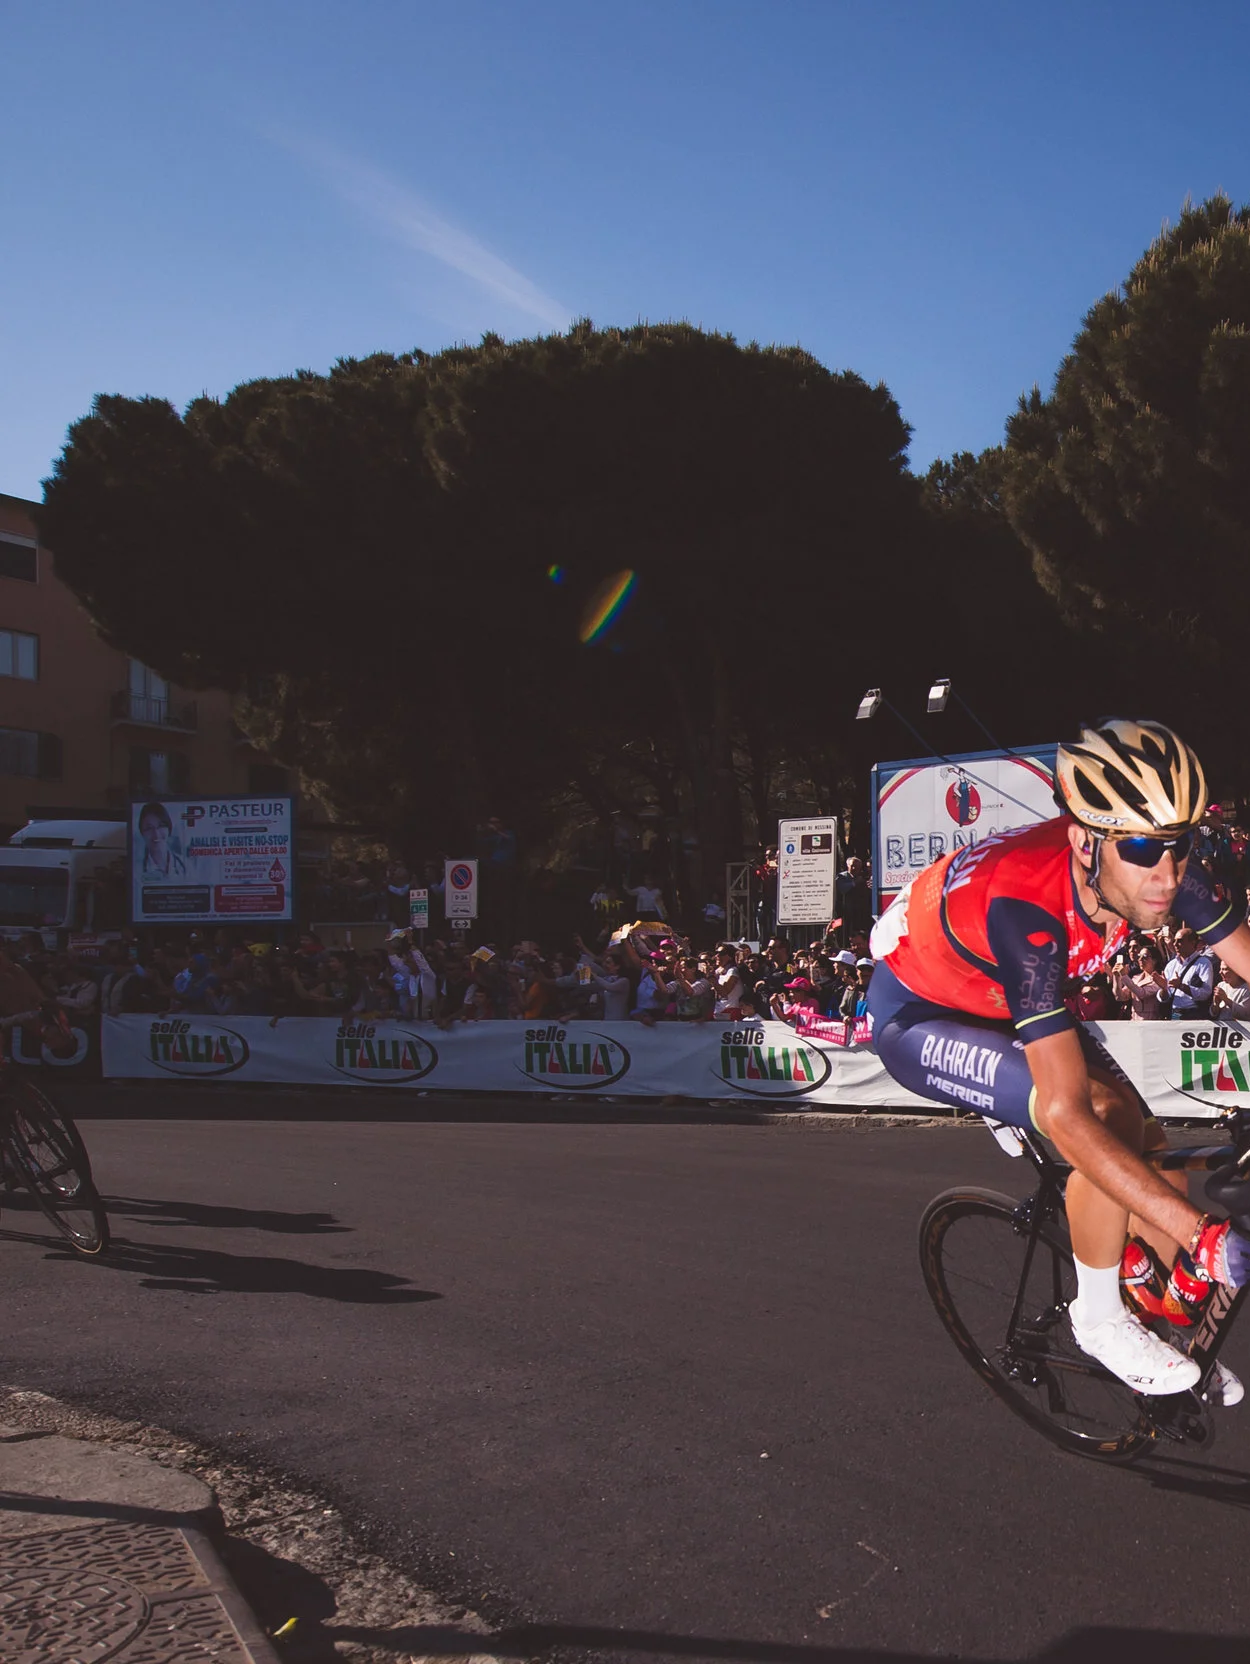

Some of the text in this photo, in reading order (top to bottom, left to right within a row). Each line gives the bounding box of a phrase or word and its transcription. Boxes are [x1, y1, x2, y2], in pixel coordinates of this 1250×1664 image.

[208, 803, 284, 817] PASTEUR
[1078, 808, 1129, 827] RUDY
[190, 834, 289, 847] ANALISI E VISITE NO-STOP
[886, 825, 1012, 870] BERN
[150, 1020, 191, 1035] selle
[336, 1023, 377, 1039] selle
[525, 1026, 567, 1043] selle
[721, 1029, 764, 1046] selle
[1180, 1029, 1245, 1049] selle
[920, 1034, 1003, 1087] BAHRAIN
[926, 1073, 994, 1111] MERIDA
